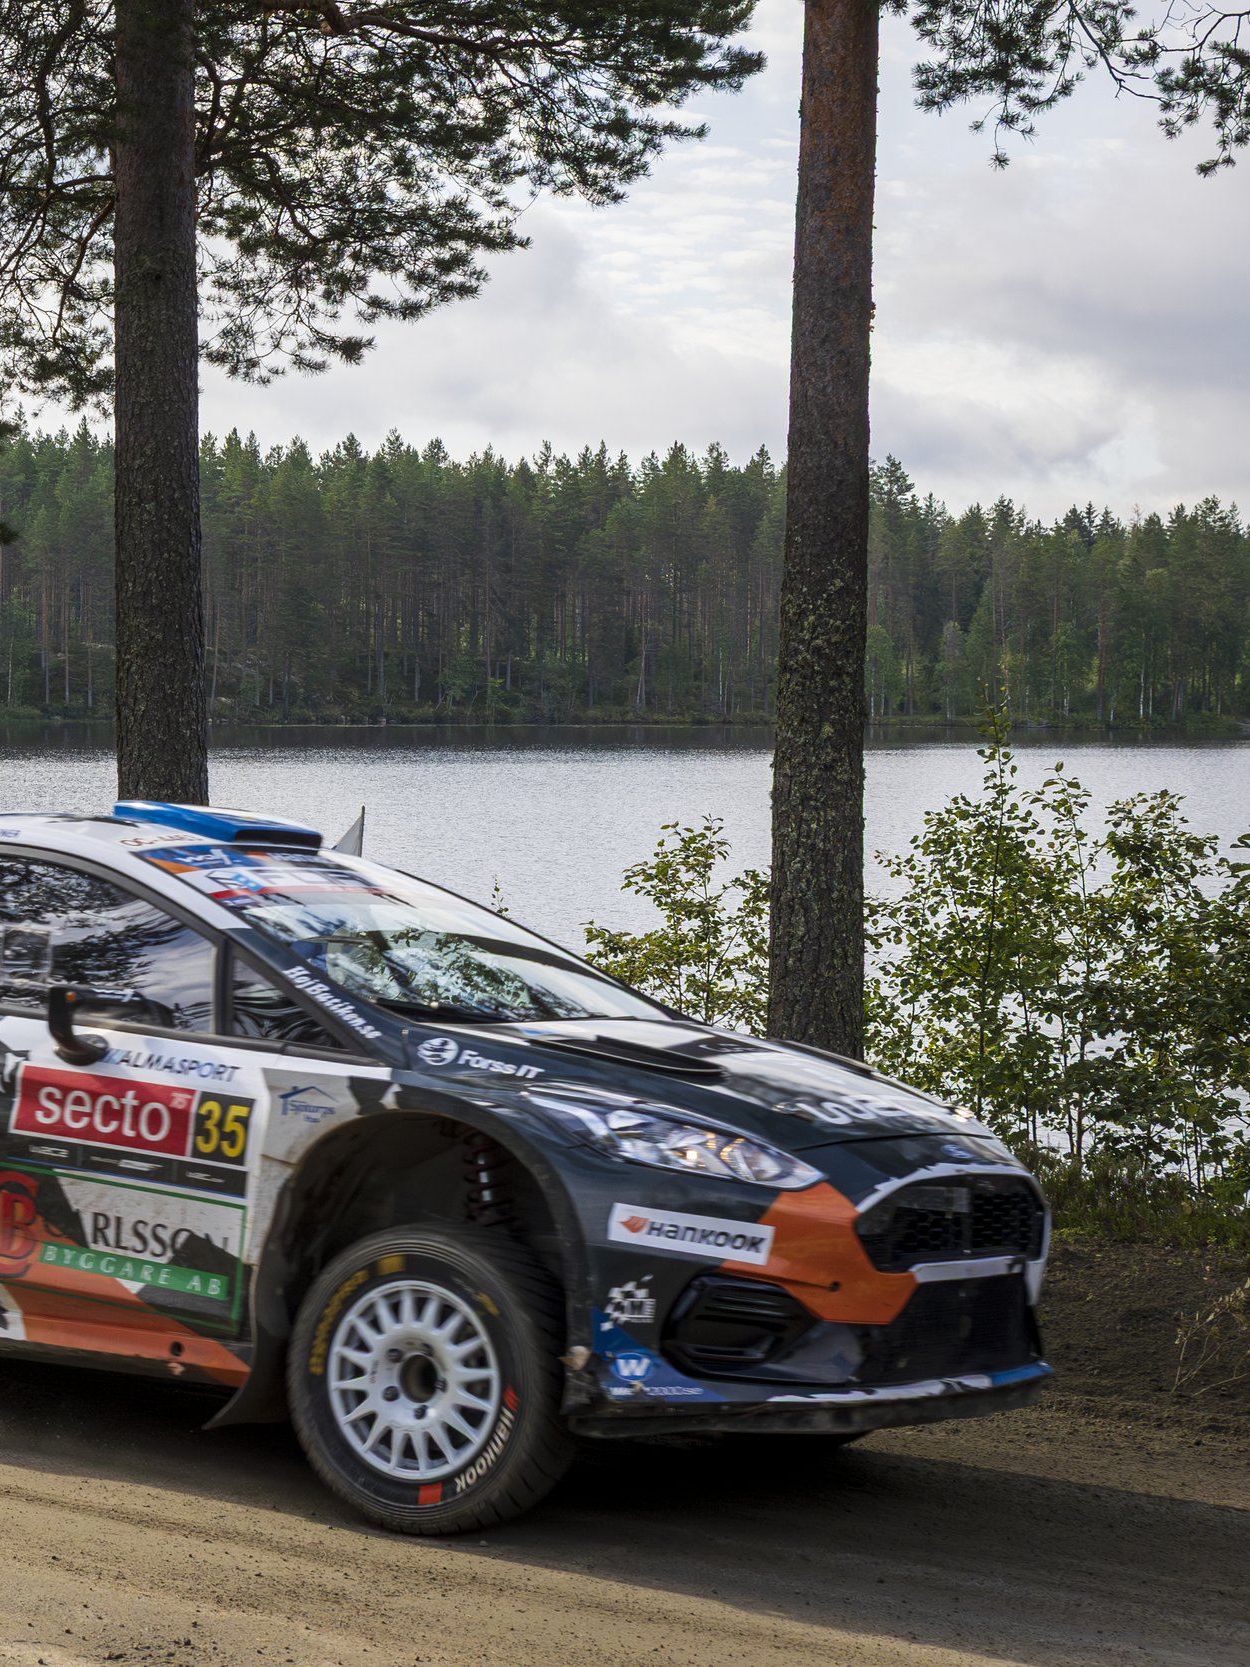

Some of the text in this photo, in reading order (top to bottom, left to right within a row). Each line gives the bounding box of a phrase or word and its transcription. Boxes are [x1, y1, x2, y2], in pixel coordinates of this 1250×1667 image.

[457, 1050, 546, 1080] Forss IT
[34, 1086, 172, 1142] secto
[195, 1100, 251, 1158] 35
[44, 1245, 173, 1285] BYGGARE
[186, 1276, 222, 1296] AB
[616, 1357, 651, 1377] W
